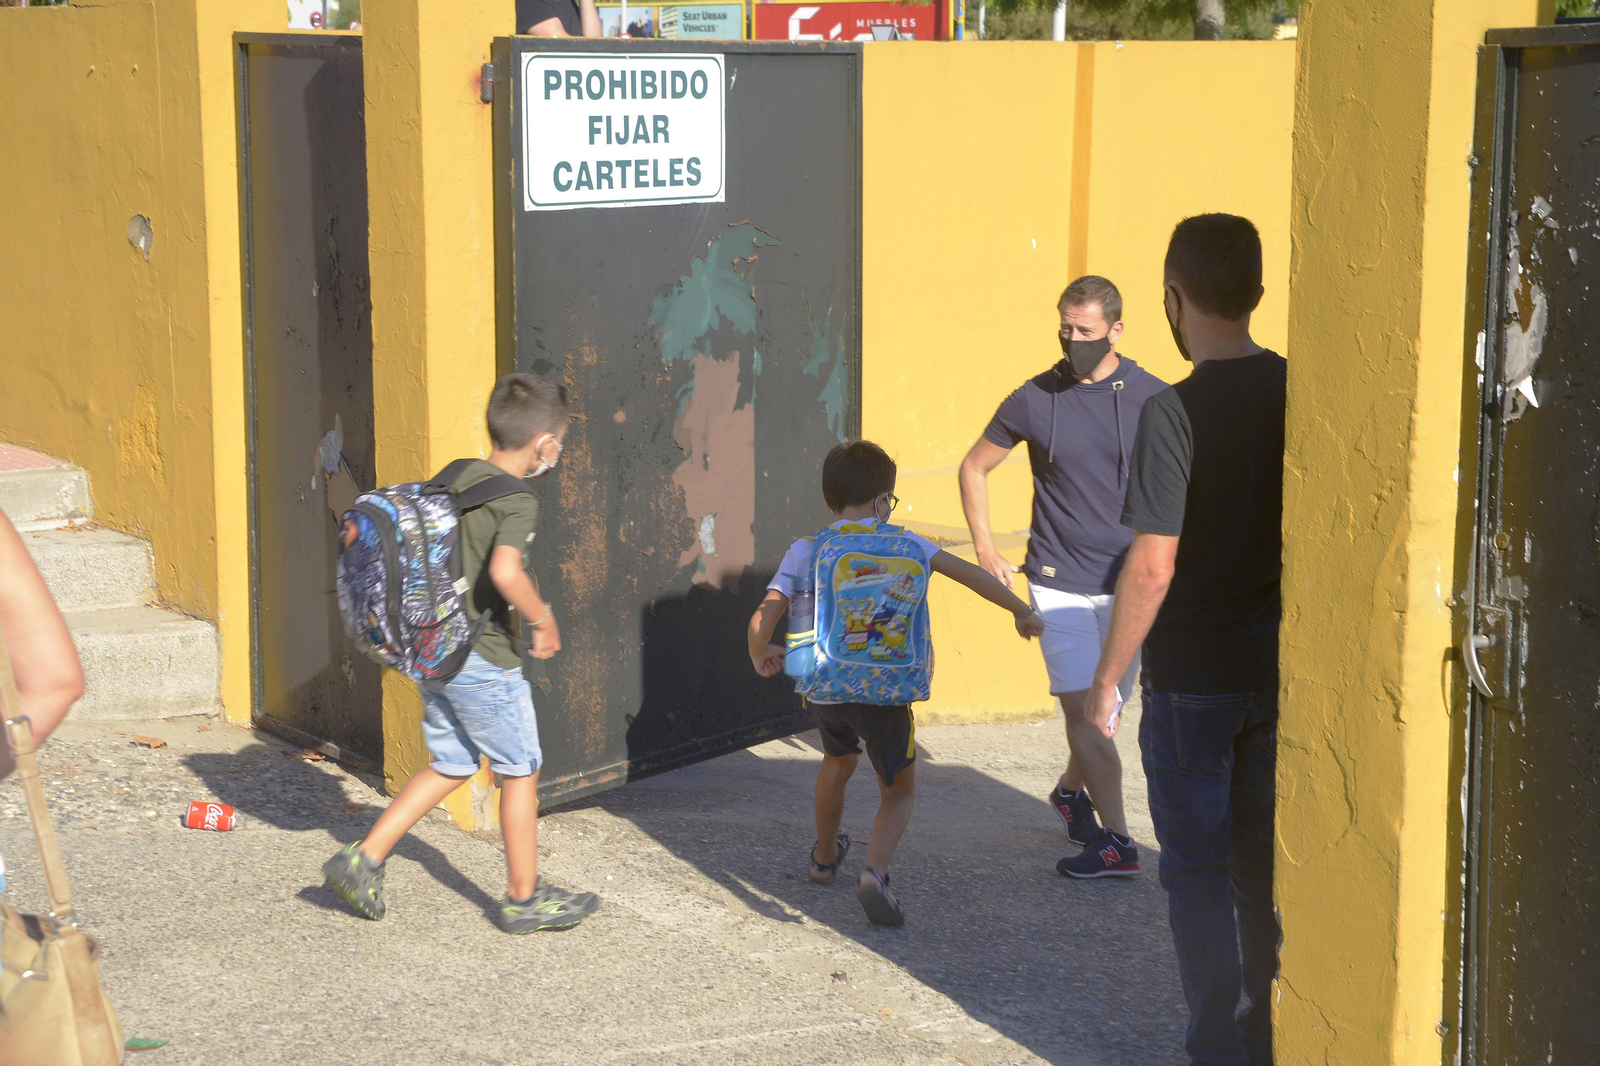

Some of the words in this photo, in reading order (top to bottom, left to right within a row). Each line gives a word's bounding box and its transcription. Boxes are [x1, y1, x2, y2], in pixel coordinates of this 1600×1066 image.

[682, 23, 716, 33] VEHICLES
[856, 18, 917, 28] MUEBLES
[543, 69, 709, 101] PROHIBIDO
[588, 114, 670, 146] FIJAR
[553, 156, 702, 193] CARTELES
[1099, 845, 1121, 867] N
